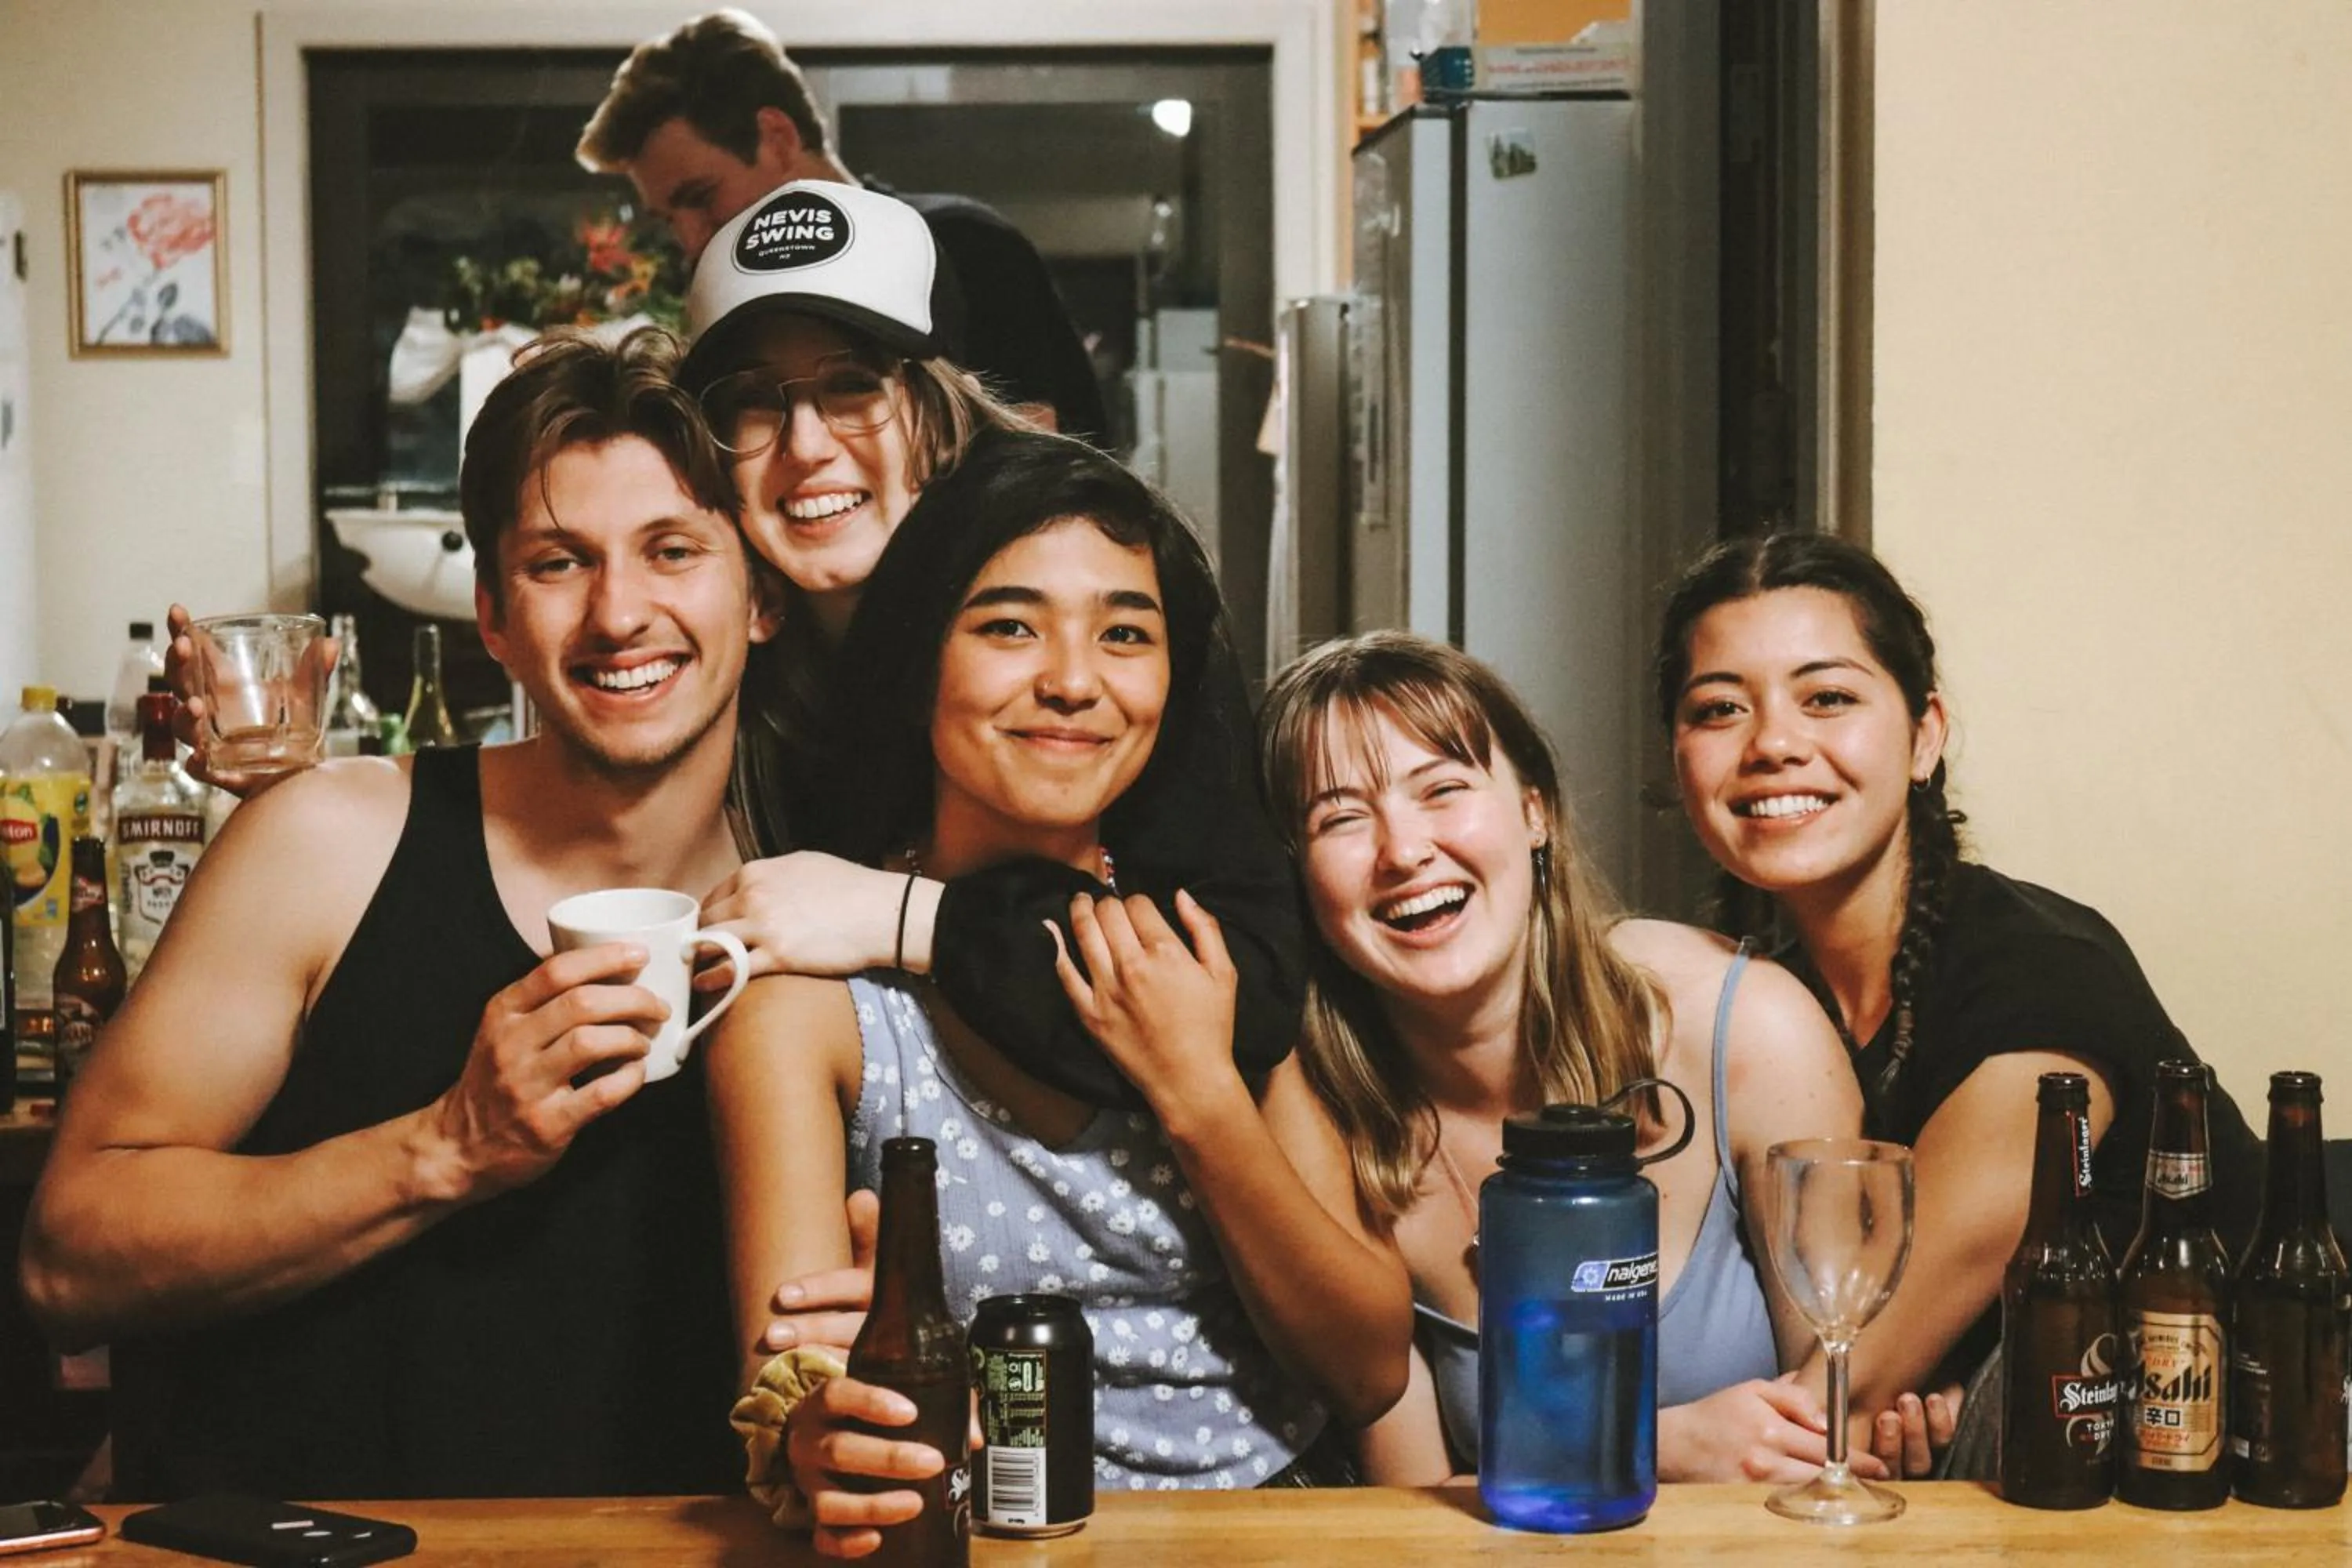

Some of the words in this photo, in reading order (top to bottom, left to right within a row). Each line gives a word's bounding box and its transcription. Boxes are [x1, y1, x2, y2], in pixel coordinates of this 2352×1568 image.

[754, 208, 832, 230] NEVIS
[746, 225, 834, 250] SWING
[758, 244, 816, 257] QUEENSTOWN
[122, 818, 200, 839] SMIRNOFF
[2078, 1116, 2092, 1189] Steinlager
[1605, 1293, 1625, 1301] MADE
[2146, 1407, 2180, 1426] 辛口
